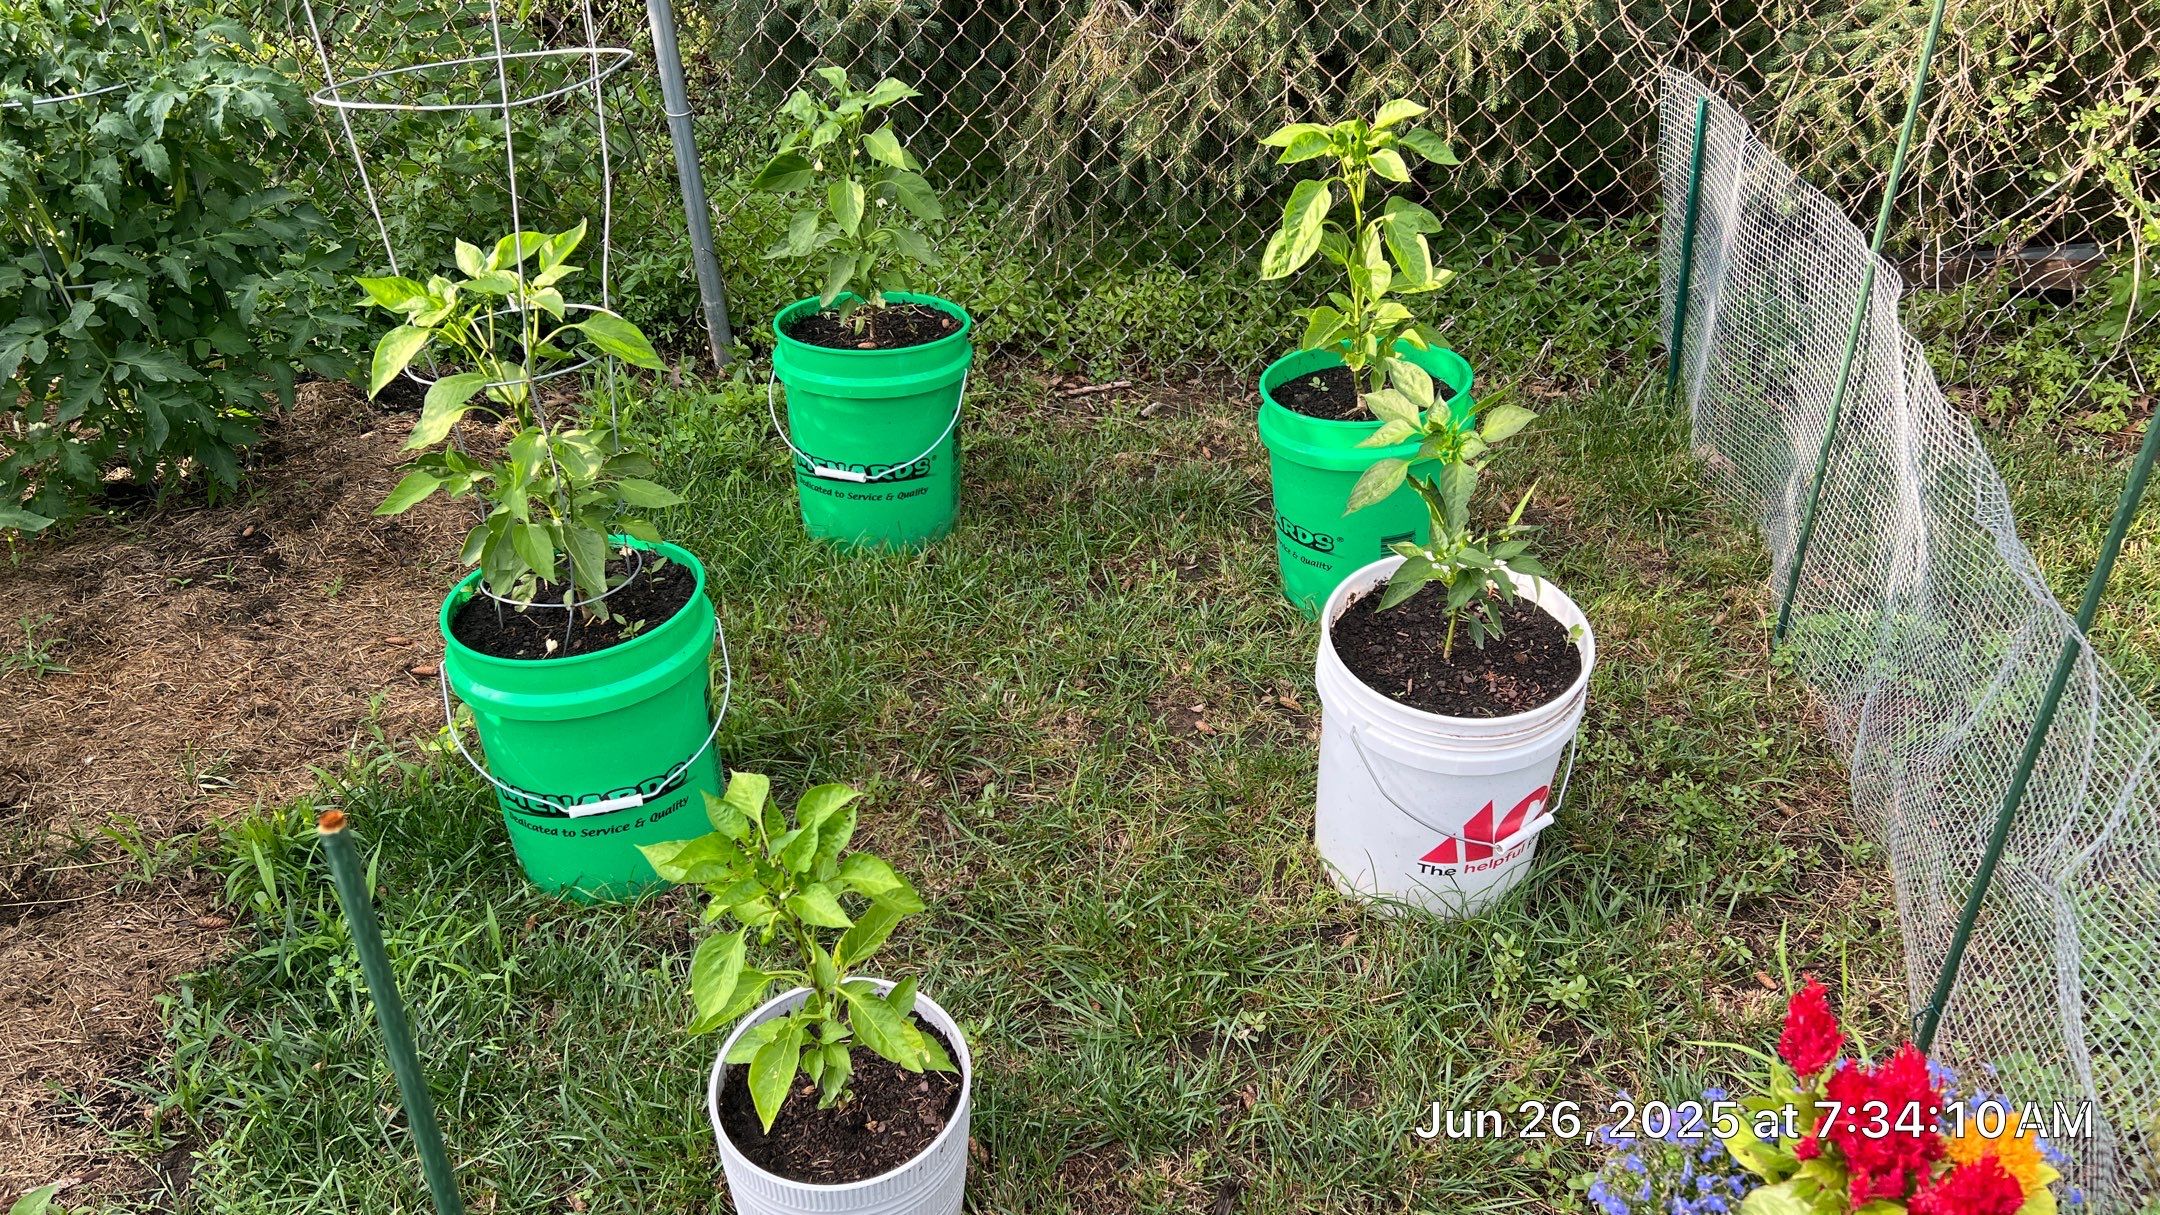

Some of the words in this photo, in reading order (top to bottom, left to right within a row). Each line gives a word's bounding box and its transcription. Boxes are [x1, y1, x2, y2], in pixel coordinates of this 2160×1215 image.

[835, 490, 845, 499] to
[847, 492, 882, 502] Service
[886, 492, 894, 501] &
[897, 487, 929, 500] Quality
[1300, 556, 1333, 572] Quality
[509, 811, 558, 837] Dedicated
[562, 827, 577, 838] to
[580, 822, 631, 838] Service
[634, 817, 647, 829] &
[650, 796, 690, 824] Quality
[1417, 862, 1457, 877] The
[1464, 845, 1526, 875] helpful
